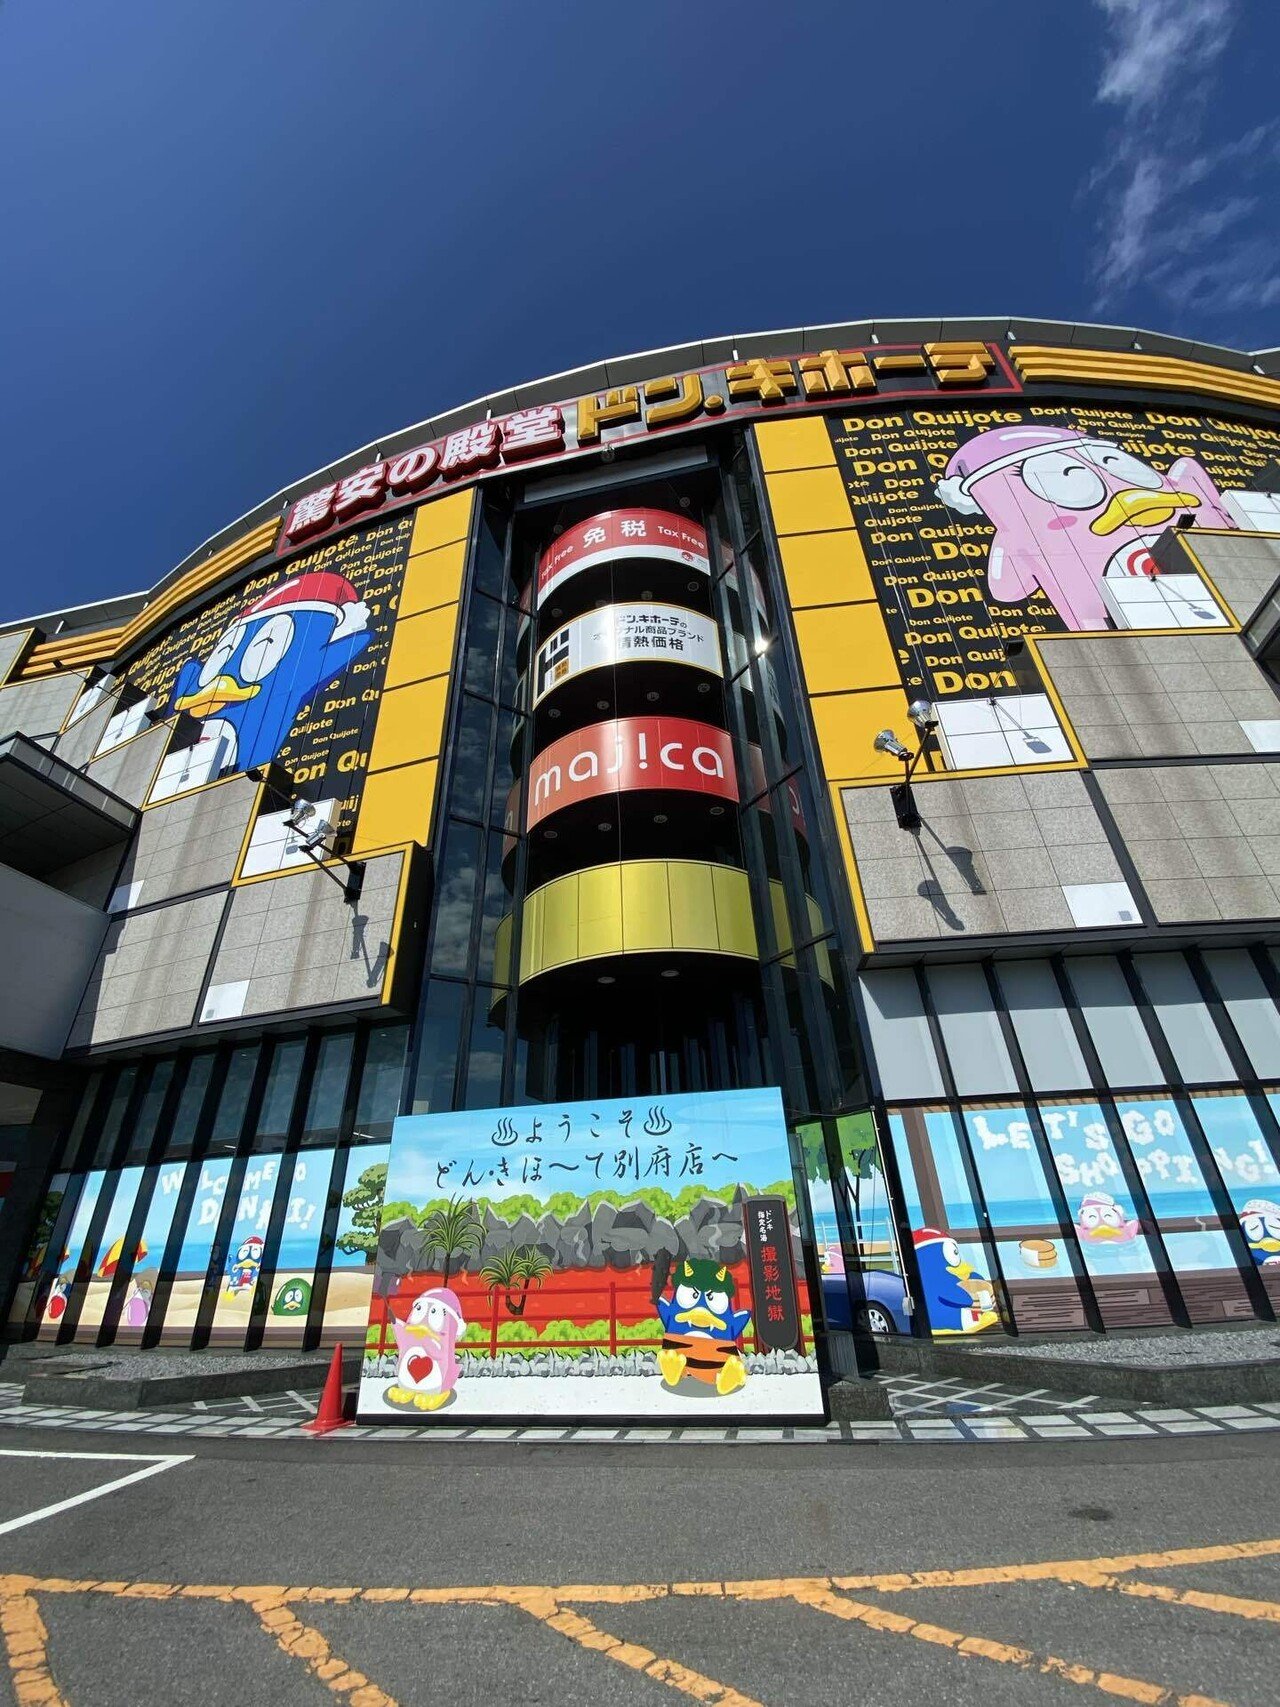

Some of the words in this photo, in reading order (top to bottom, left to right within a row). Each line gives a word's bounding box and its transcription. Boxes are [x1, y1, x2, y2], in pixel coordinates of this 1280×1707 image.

[842, 415, 904, 432] Don
[912, 409, 1023, 427] Quijote
[1030, 407, 1068, 415] Don
[1070, 408, 1133, 419] Quijote
[1145, 412, 1202, 427] Don
[871, 432, 900, 441] Don
[903, 428, 956, 438] Quijote
[1161, 430, 1198, 440] Don
[1200, 433, 1257, 449] Quijote
[845, 447, 883, 457] Don
[888, 440, 959, 453] Quijote
[286, 405, 564, 536] 驚安の殿堂
[853, 457, 918, 476] Don
[884, 477, 924, 489] Don
[864, 514, 923, 527] Quijote
[365, 527, 394, 541] Don
[870, 531, 914, 544] Don
[919, 524, 996, 540] Quijote
[554, 545, 574, 565] Free
[657, 525, 679, 538] Tax
[682, 532, 705, 549] Free
[363, 546, 404, 564] Quijote
[871, 558, 893, 567] Don
[894, 554, 932, 564] Quijote
[243, 571, 280, 596] Don
[285, 534, 359, 575] Quijote
[314, 560, 332, 572] Don
[374, 563, 404, 579] Don
[883, 574, 919, 586] Don
[922, 568, 985, 582] Quijote
[363, 583, 393, 600] Don
[907, 587, 984, 608] Don
[909, 617, 931, 626] Don
[933, 613, 973, 624] Quijote
[988, 606, 1023, 617] Don
[190, 627, 223, 654] Don
[904, 631, 953, 646] Don
[353, 660, 377, 674] Don
[925, 656, 963, 667] Don
[932, 669, 1017, 694] Don
[324, 695, 357, 713] Don
[289, 718, 333, 738] Quijote
[312, 736, 329, 745] Don
[329, 727, 359, 740] Quijote
[301, 749, 330, 762] Quijote
[525, 1109, 632, 1143] ようこそ
[972, 1110, 1109, 1150] LET'S
[1122, 1109, 1175, 1145] GO
[760, 1246, 785, 1322] 撮影地獄
